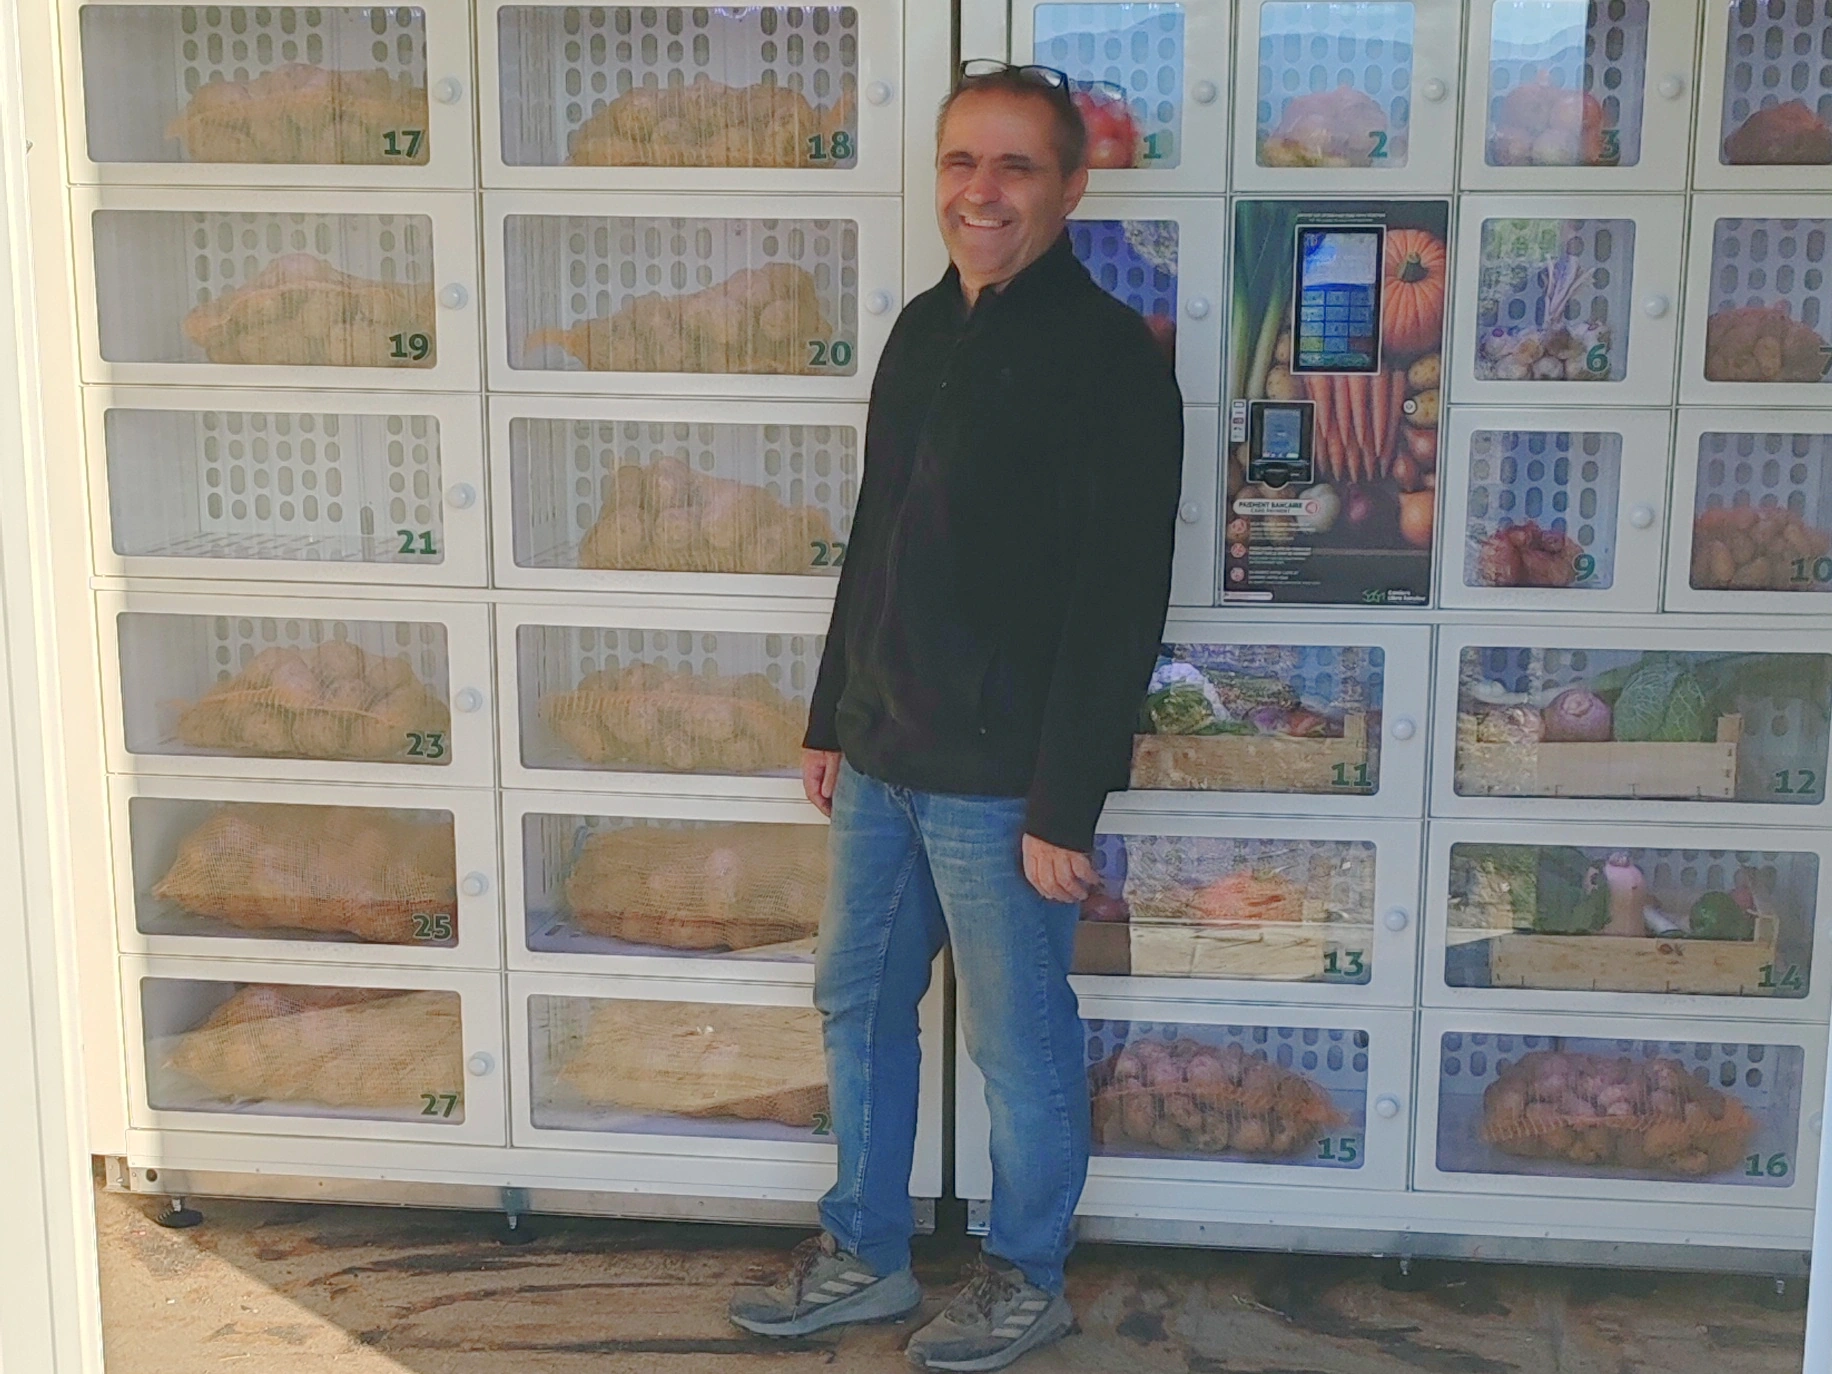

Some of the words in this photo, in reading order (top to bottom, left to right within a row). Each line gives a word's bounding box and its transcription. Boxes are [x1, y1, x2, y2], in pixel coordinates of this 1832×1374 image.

[382, 130, 421, 158] 17
[808, 131, 850, 159] 18
[1143, 132, 1162, 159] 1
[1368, 131, 1388, 158] 2
[1599, 129, 1619, 159] 3
[389, 333, 429, 360] 19
[809, 340, 853, 366] 20
[1586, 343, 1608, 372] 6
[397, 530, 438, 555] 21
[810, 542, 846, 567] 22
[1574, 554, 1596, 581] 9
[1790, 557, 1832, 583] 10
[406, 733, 445, 758] 23
[1331, 762, 1372, 787] 11
[1774, 769, 1816, 794] 12
[413, 914, 452, 940] 25
[1324, 951, 1365, 977] 13
[1758, 964, 1801, 990] 14
[420, 1093, 458, 1118] 27
[811, 1112, 830, 1136] 2
[1318, 1137, 1357, 1162] 15
[1745, 1153, 1788, 1178] 16
